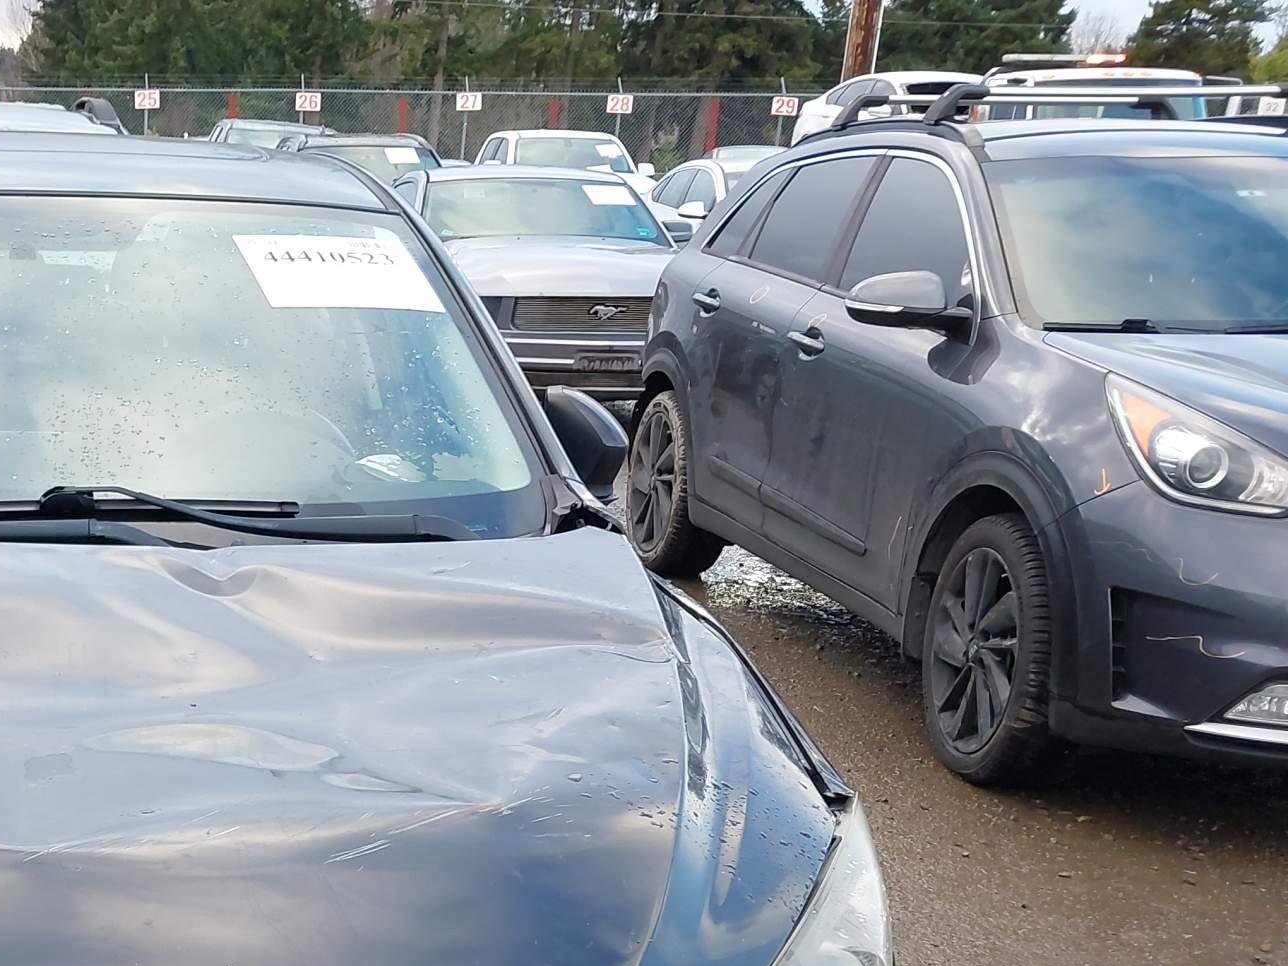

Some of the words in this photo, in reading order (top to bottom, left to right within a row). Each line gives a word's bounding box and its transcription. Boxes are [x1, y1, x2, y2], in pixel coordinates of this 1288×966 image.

[137, 92, 158, 108] 25
[298, 94, 318, 110] 26
[459, 94, 479, 109] 27
[609, 96, 630, 112] 28
[774, 98, 796, 115] 29
[263, 250, 395, 266] 44410523
